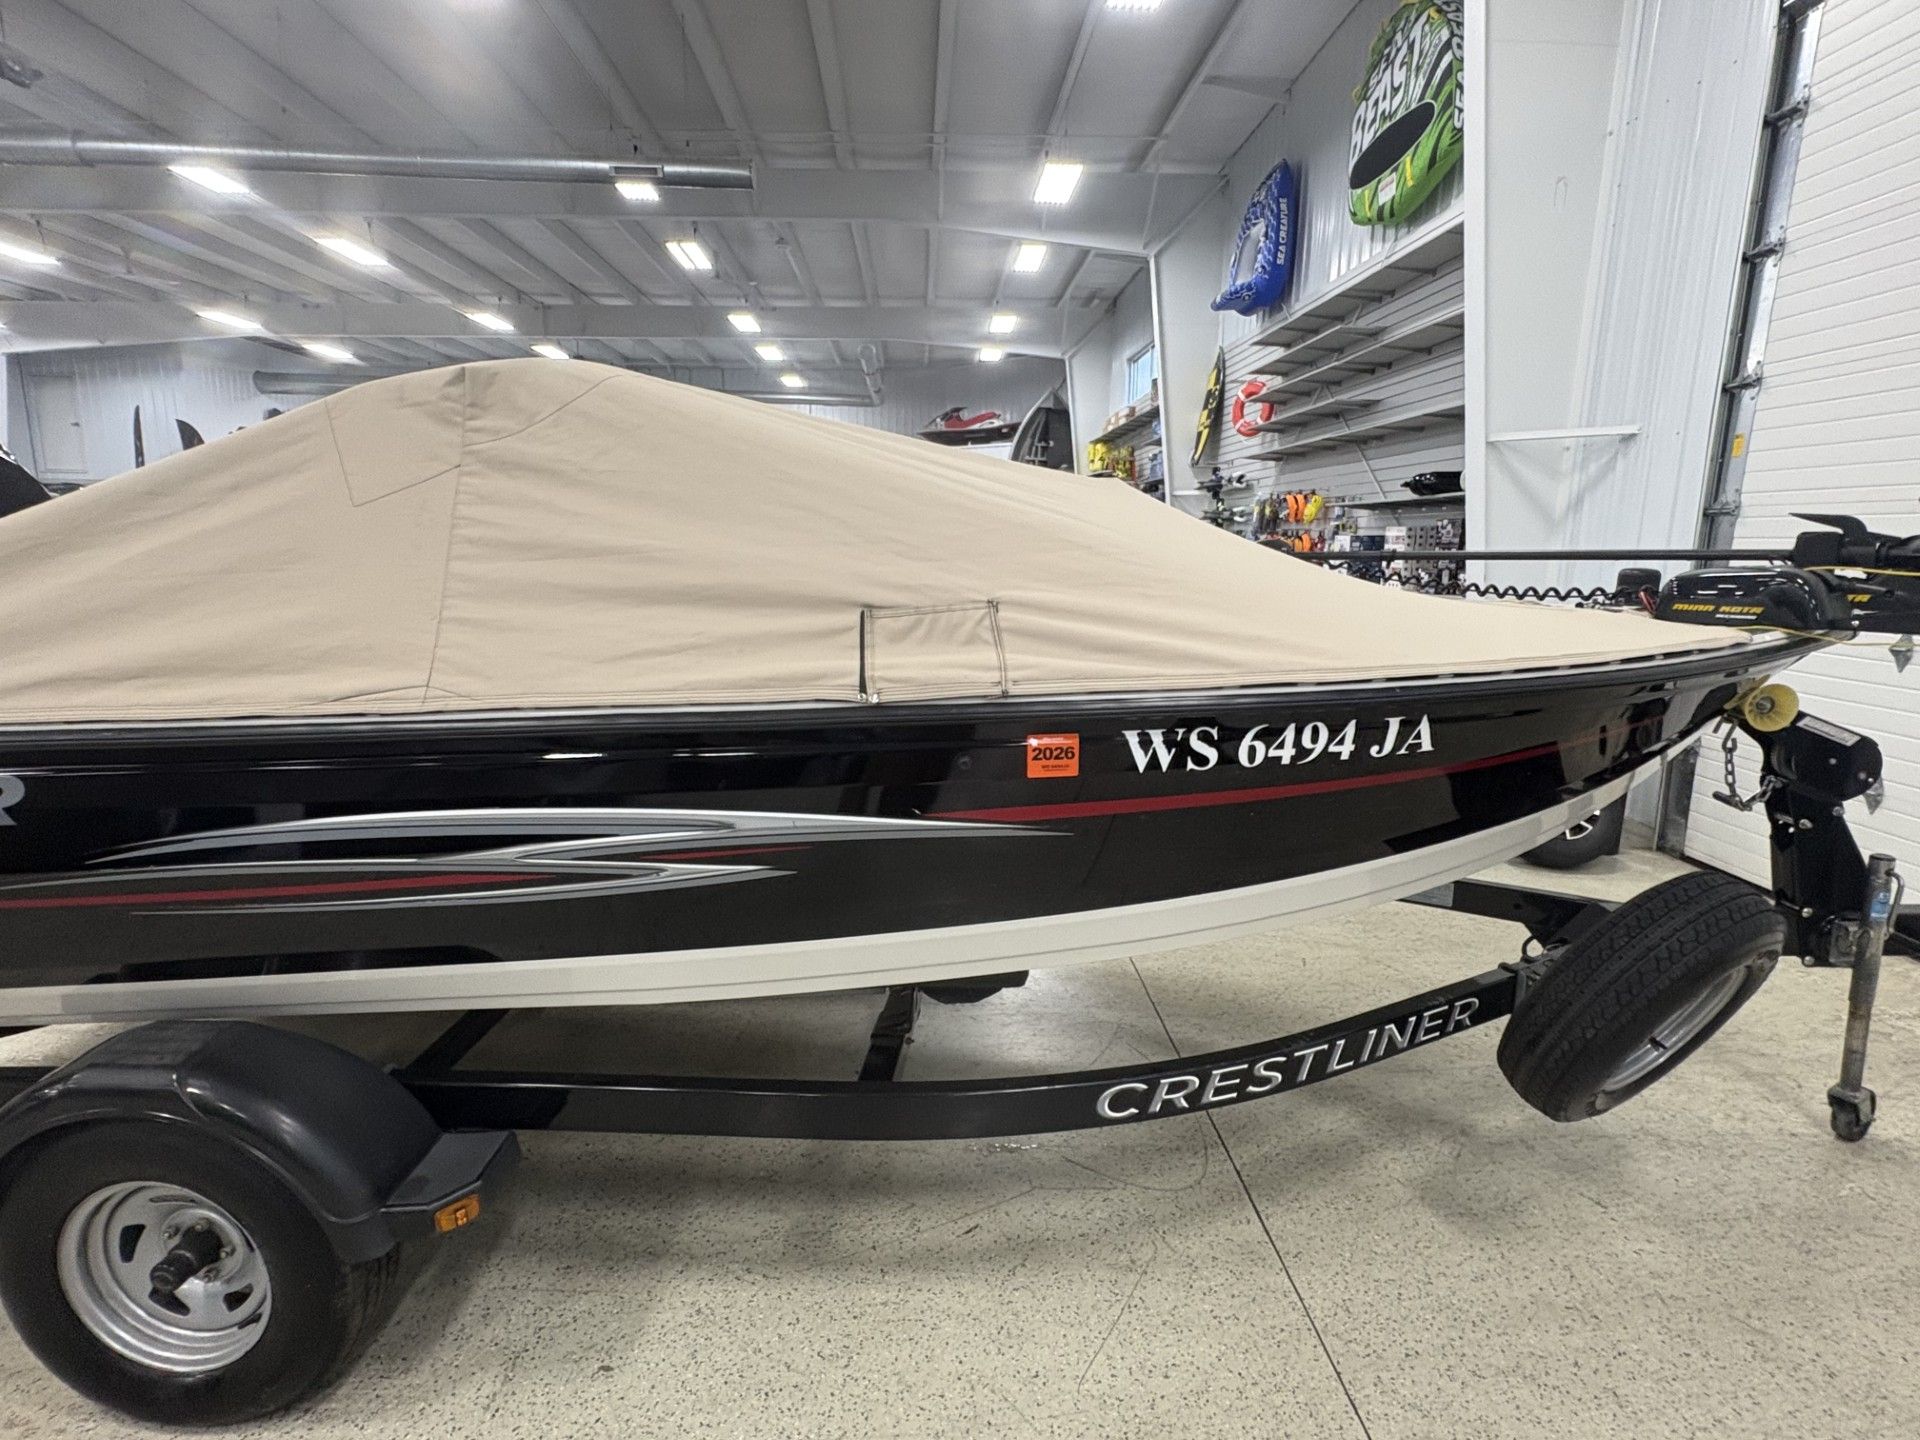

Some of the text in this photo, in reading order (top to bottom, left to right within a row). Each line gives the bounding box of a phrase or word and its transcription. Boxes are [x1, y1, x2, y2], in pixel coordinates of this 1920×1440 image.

[1277, 197, 1288, 265] SEA CREATURE
[1032, 746, 1076, 761] 2026
[1122, 714, 1434, 774] WS 6494 JA
[1096, 997, 1480, 1119] CRESTLINER
